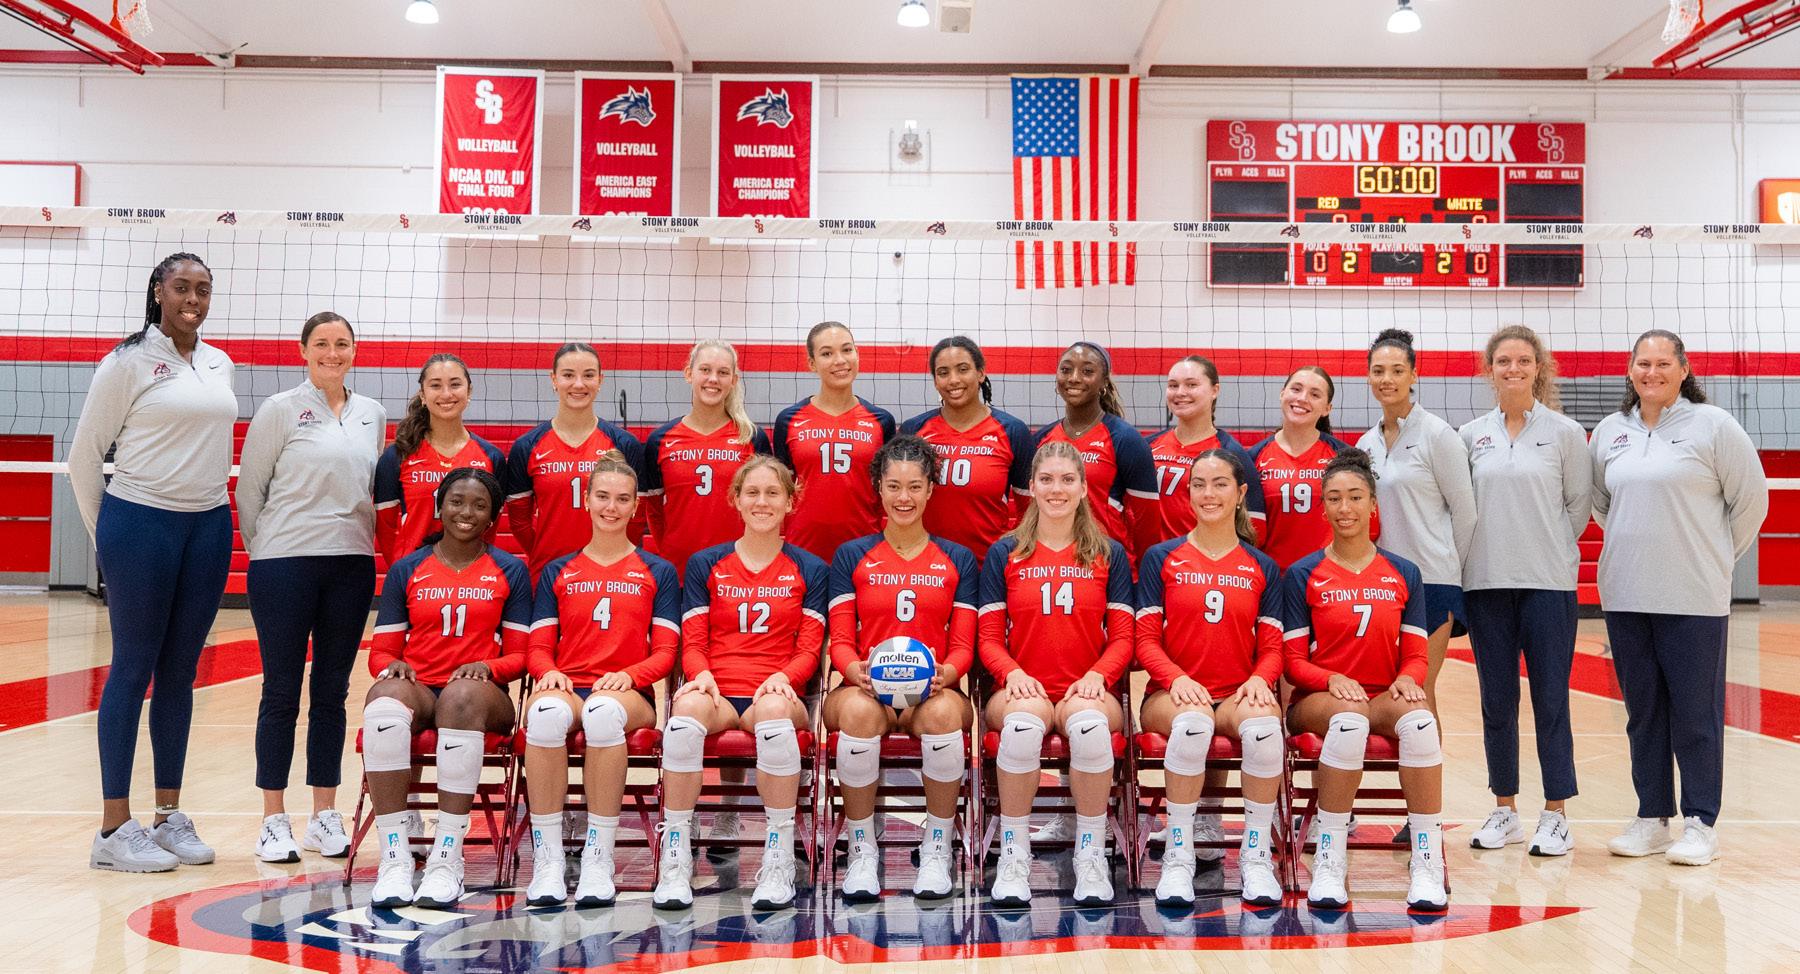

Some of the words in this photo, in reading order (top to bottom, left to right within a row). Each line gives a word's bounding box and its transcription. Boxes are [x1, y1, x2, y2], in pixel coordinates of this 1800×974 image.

[457, 138, 518, 153] VOLLEYBALL
[596, 142, 658, 156] VOLLEYBALL
[1276, 123, 1385, 161] STONY
[1399, 124, 1517, 162] BROOK
[734, 144, 796, 158] VOLLEYBALL
[449, 168, 482, 183] NCAA
[485, 169, 508, 185] DIV.
[512, 170, 525, 185] III
[1215, 167, 1233, 177] PLYR
[1241, 168, 1259, 177] ACES
[1267, 168, 1286, 177] KILLS
[1509, 170, 1527, 179] PLYR
[1535, 170, 1553, 179] ACES
[1561, 170, 1579, 180] KILLS
[595, 175, 634, 187] AMERICA
[636, 176, 657, 187] EAST
[733, 177, 772, 189] AMERICA
[774, 178, 795, 189] EAST
[1359, 167, 1435, 193] 60:00
[457, 184, 485, 197] FINAL
[488, 185, 515, 198] FOUR
[600, 187, 652, 198] CHAMPIONS
[738, 189, 790, 200] CHAMPIONS
[1317, 197, 1340, 209] RED
[1447, 198, 1483, 210] WHITE
[108, 208, 134, 218] STONY
[137, 209, 165, 219] BROOK
[287, 212, 313, 221] STONY
[315, 213, 344, 222] BROOK
[465, 215, 490, 224] STONY
[493, 215, 521, 225] BROOK
[642, 218, 668, 227] STONY
[670, 218, 698, 227] BROOK
[820, 220, 845, 229] STONY
[847, 220, 876, 229] BROOK
[997, 222, 1022, 231] STONY
[1025, 222, 1053, 232] BROOK
[1174, 223, 1199, 232] STONY
[1202, 223, 1230, 232] BROOK
[1350, 224, 1376, 233] STONY
[1378, 224, 1406, 233] BROOK
[1527, 225, 1552, 234] STONY
[1555, 225, 1583, 235] BROOK
[1704, 225, 1730, 234] STONY
[1732, 225, 1760, 235] BROOK
[1313, 252, 1326, 272] 0
[1343, 252, 1357, 273] 2
[1437, 253, 1451, 274] 2
[1473, 253, 1487, 274] 0
[1469, 277, 1488, 286] WON
[798, 429, 834, 442] STONY
[838, 429, 873, 443] BROOK
[669, 449, 704, 461] STONY
[707, 449, 741, 461] BROOK
[930, 444, 957, 455] TONY
[960, 446, 994, 456] BROOK
[819, 442, 853, 474] 15
[540, 461, 574, 475] STONY
[1260, 469, 1296, 481] STONY
[1299, 469, 1326, 480] BROO
[695, 464, 713, 496] 3
[1157, 465, 1186, 496] 17
[570, 477, 582, 509] 1
[1280, 483, 1312, 513] 19
[1019, 566, 1056, 580] STONY
[1060, 567, 1094, 580] BROOK
[869, 573, 906, 585] STONY
[910, 574, 944, 588] BROOK
[1175, 573, 1213, 586] STONY
[1217, 574, 1253, 590] BROOK
[417, 588, 453, 600] STONY
[457, 587, 494, 600] BROOK
[566, 581, 602, 595] STONY
[606, 581, 642, 596] BROOK
[717, 584, 754, 598] STONY
[757, 586, 793, 598] BROOK
[1040, 582, 1074, 615] 14
[1321, 589, 1359, 604] STONY
[1362, 588, 1396, 602] BROOK
[896, 588, 917, 622] 6
[1203, 590, 1225, 624] 9
[440, 604, 467, 637] 11
[592, 597, 612, 630] 4
[737, 602, 771, 634] 12
[1353, 604, 1373, 637] 7
[879, 653, 919, 664] molten
[882, 667, 916, 679] NCAA
